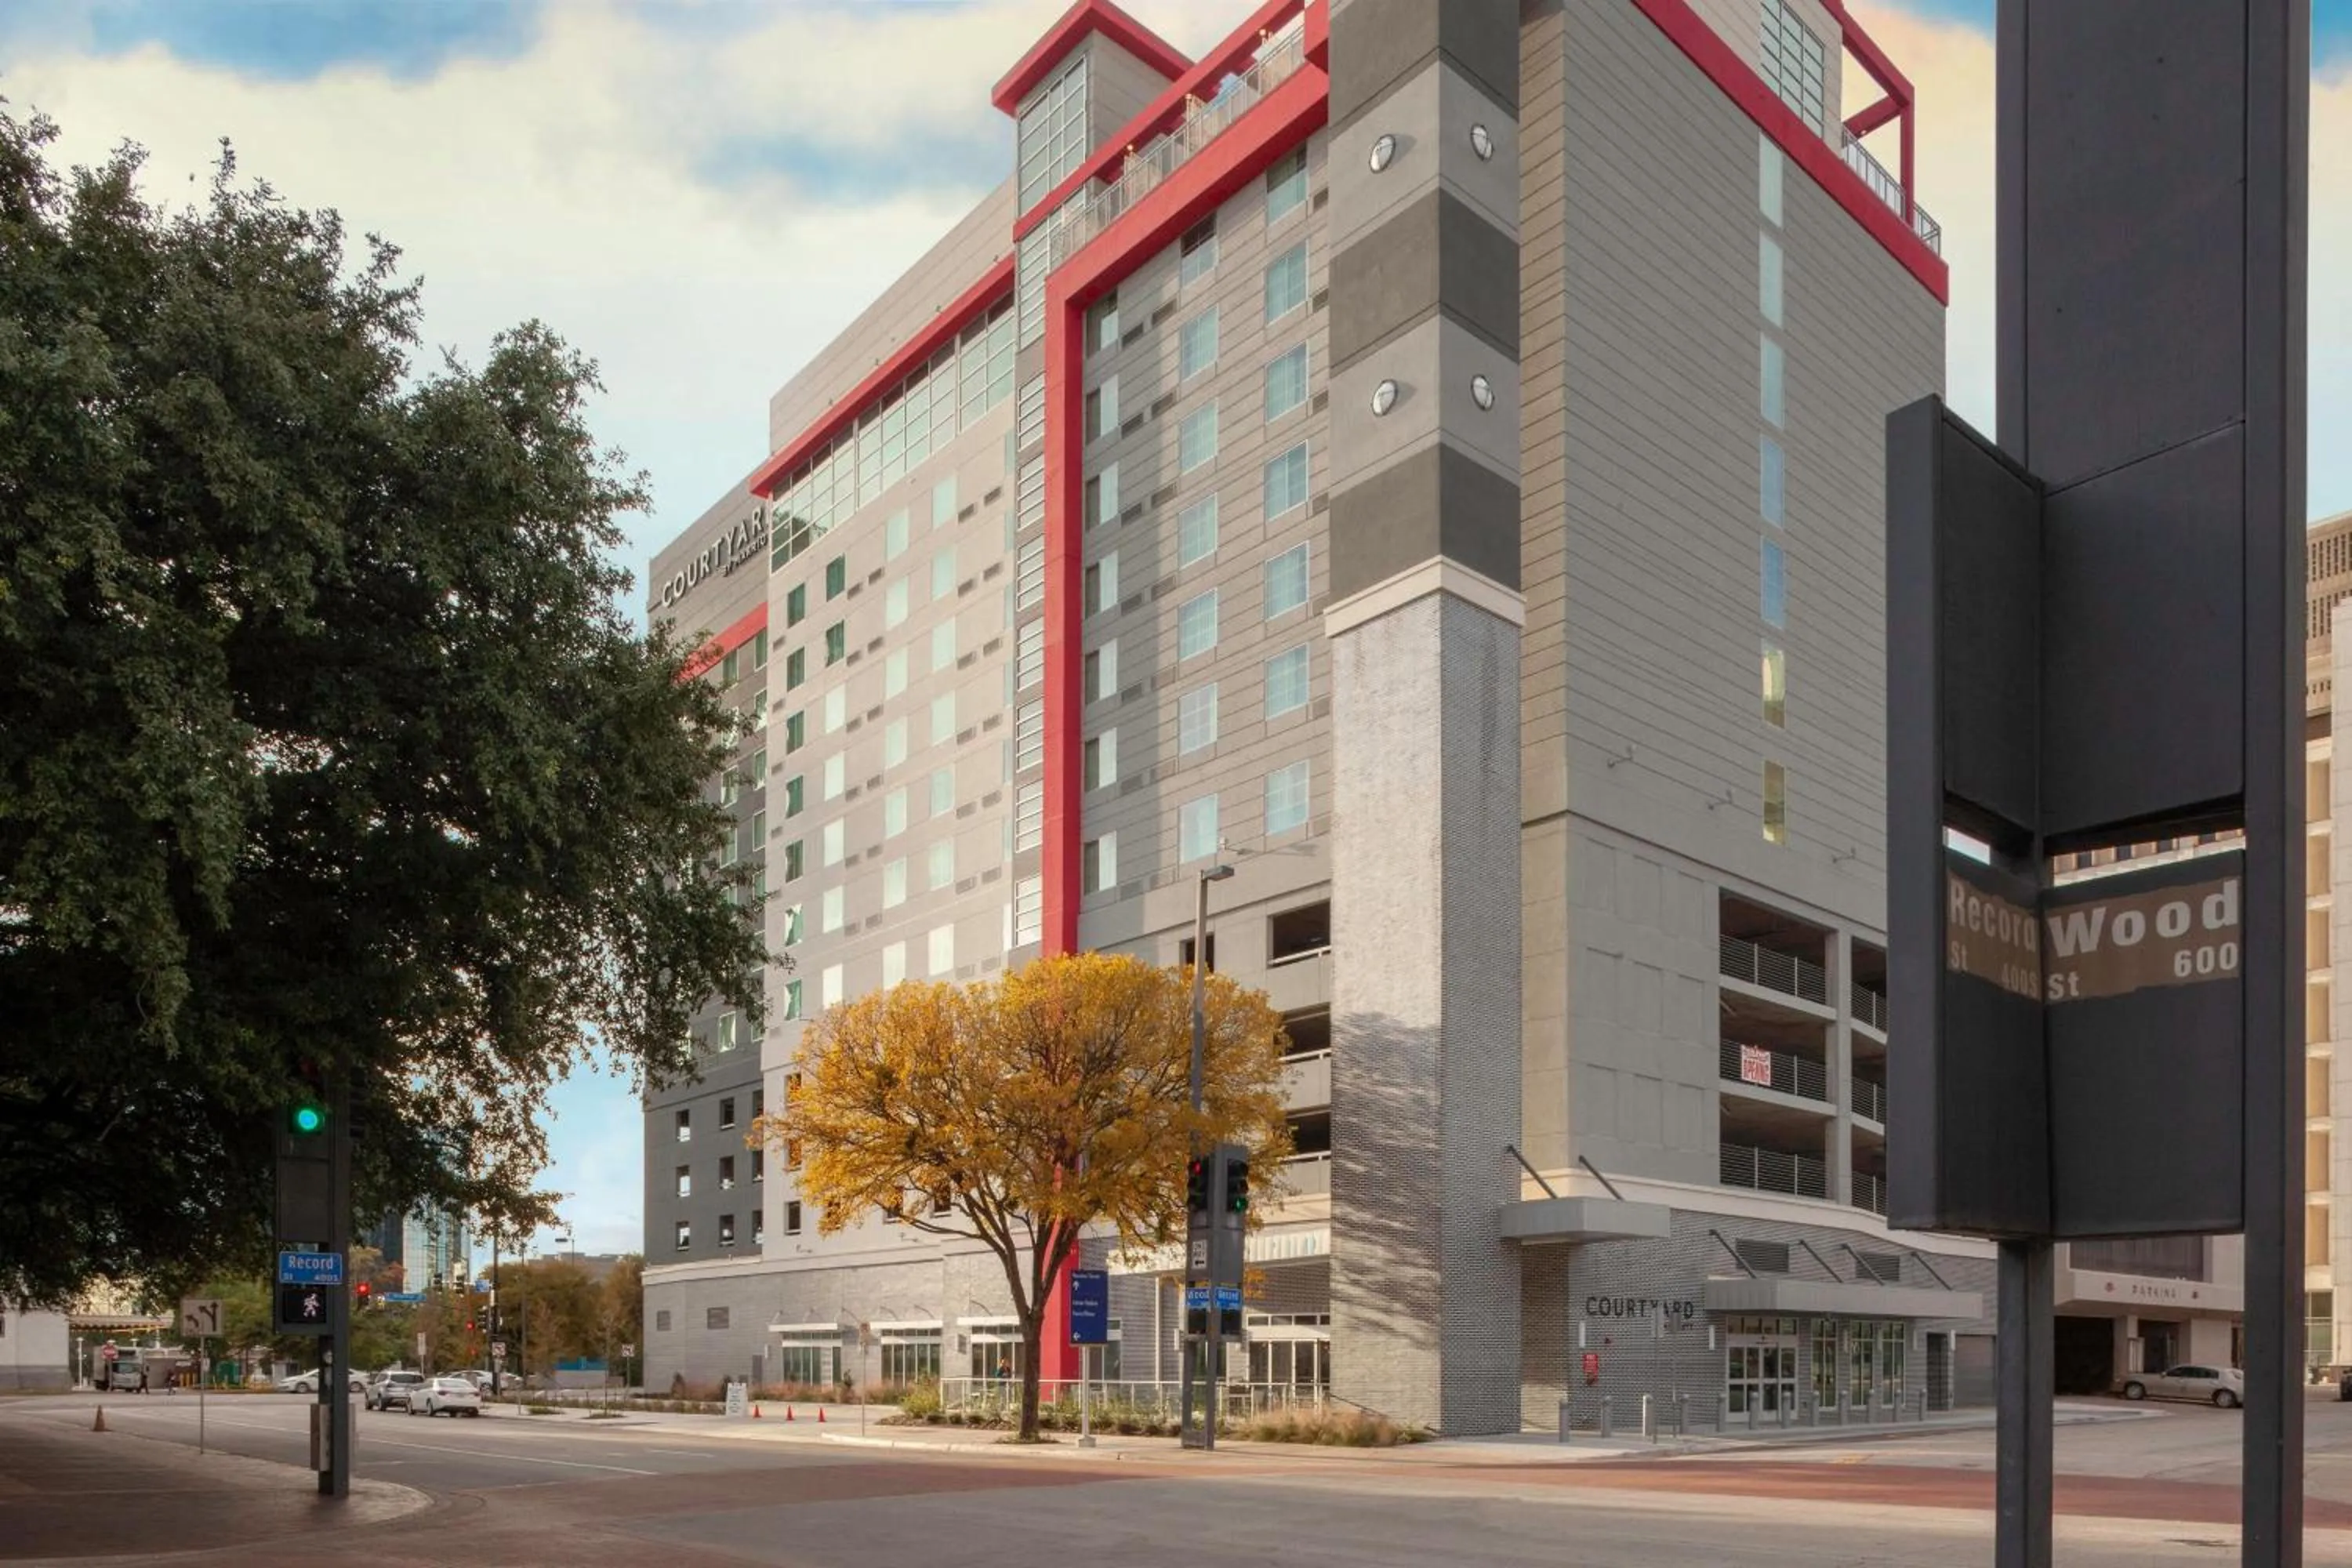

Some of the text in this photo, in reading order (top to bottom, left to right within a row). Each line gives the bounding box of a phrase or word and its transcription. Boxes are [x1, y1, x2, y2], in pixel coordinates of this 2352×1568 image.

[661, 504, 769, 608] COURTYAR
[1949, 876, 2037, 953] Record
[2047, 879, 2239, 958] Wood
[1951, 943, 2038, 998] St 400S
[2048, 941, 2239, 1000] St 600
[288, 1255, 333, 1269] Record
